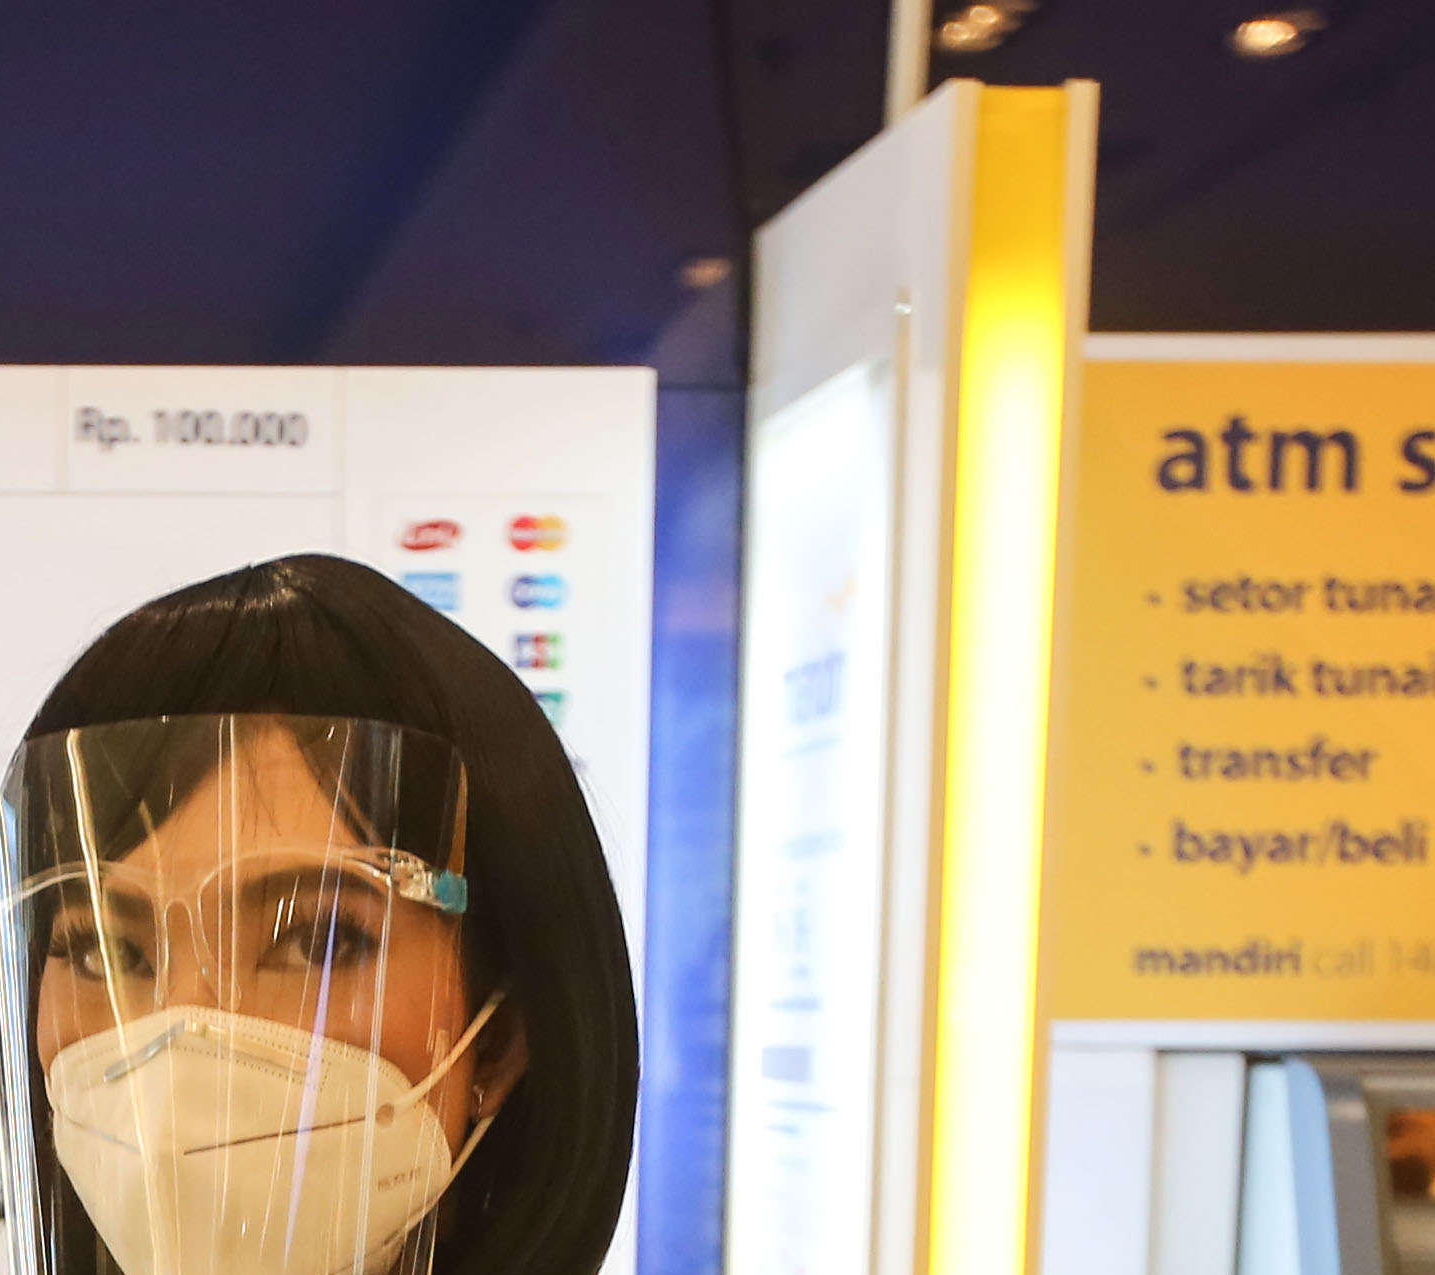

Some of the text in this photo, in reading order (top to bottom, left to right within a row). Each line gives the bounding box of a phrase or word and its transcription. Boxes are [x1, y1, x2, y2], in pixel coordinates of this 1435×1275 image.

[76, 404, 307, 451] Rp. 100.000
[1155, 414, 1359, 494] atm
[1182, 574, 1308, 614] setor
[1181, 654, 1298, 698] tarik
[1176, 737, 1376, 783] transfer
[1172, 819, 1429, 867] bayar/beli
[1135, 941, 1303, 976] mandiri
[1312, 941, 1375, 977] call
